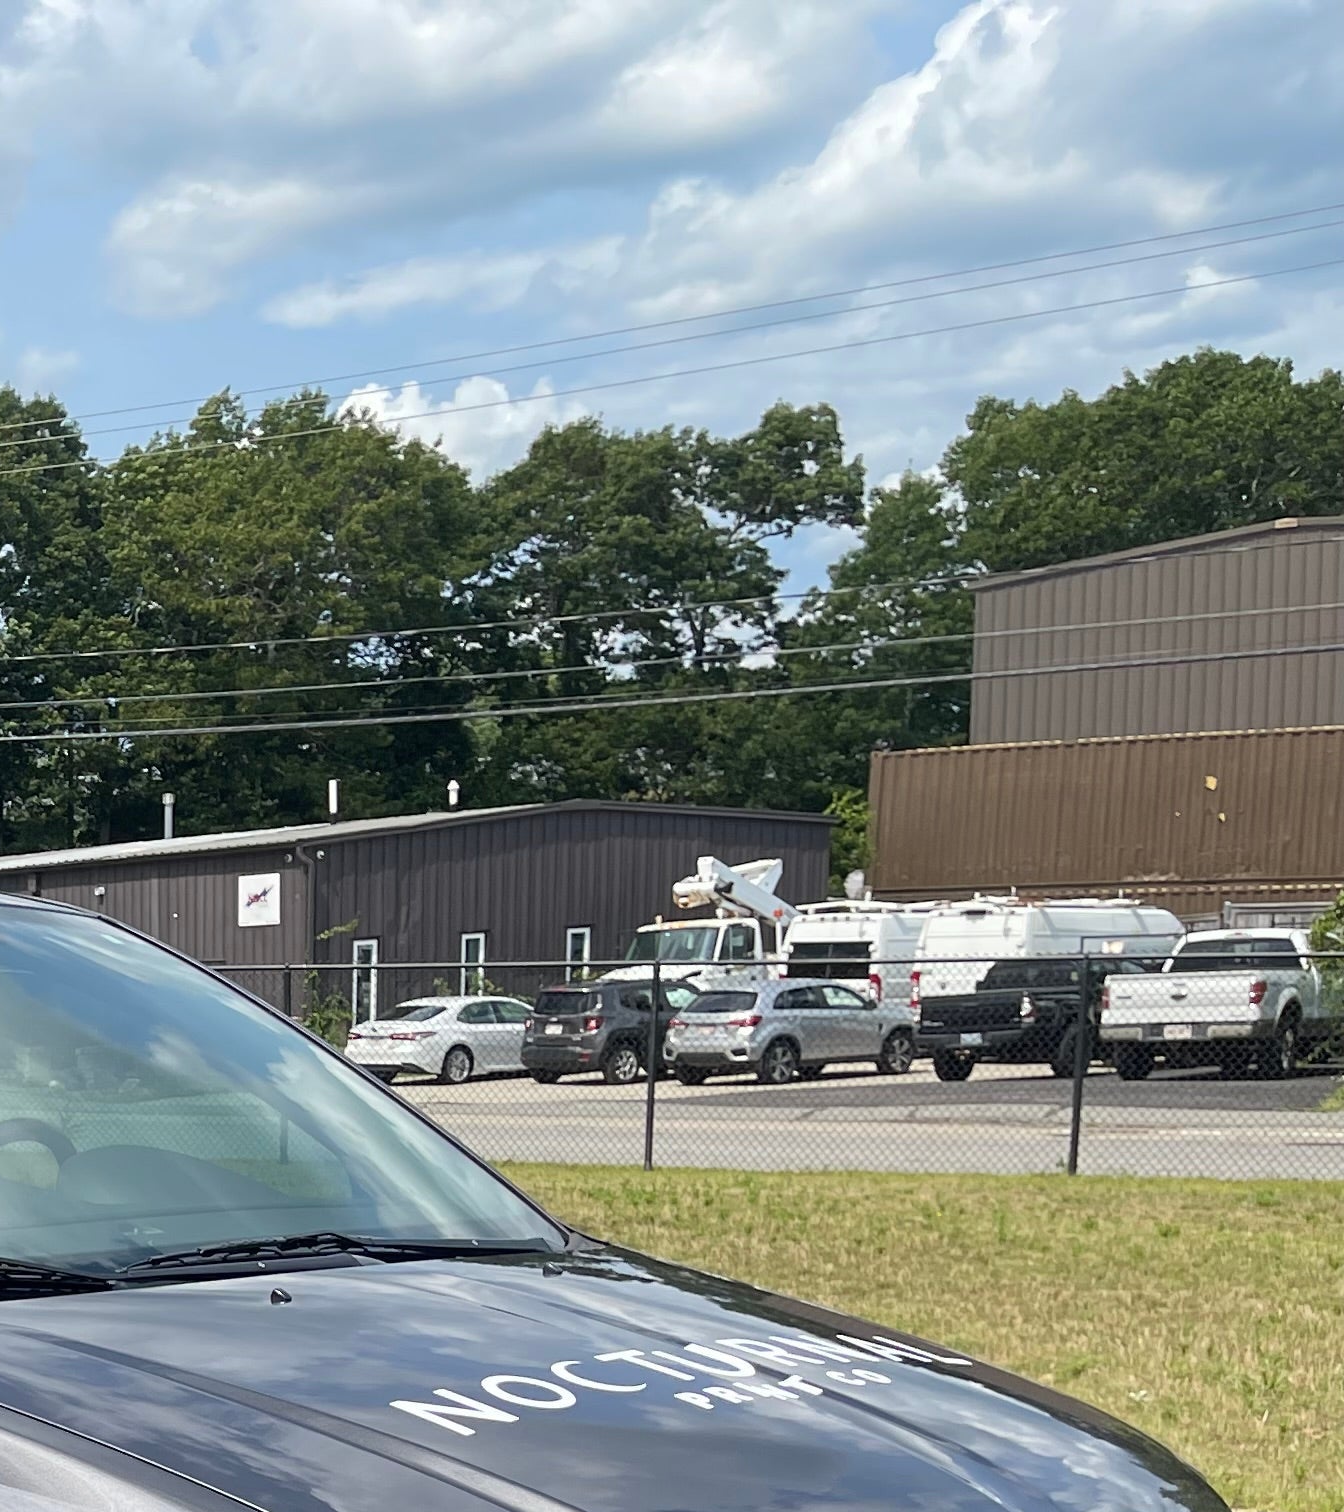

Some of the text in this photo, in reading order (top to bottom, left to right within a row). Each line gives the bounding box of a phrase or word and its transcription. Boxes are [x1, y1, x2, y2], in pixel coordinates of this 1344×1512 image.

[389, 1334, 973, 1436] NOCTURNAL
[674, 1368, 892, 1409] PRINT CO
